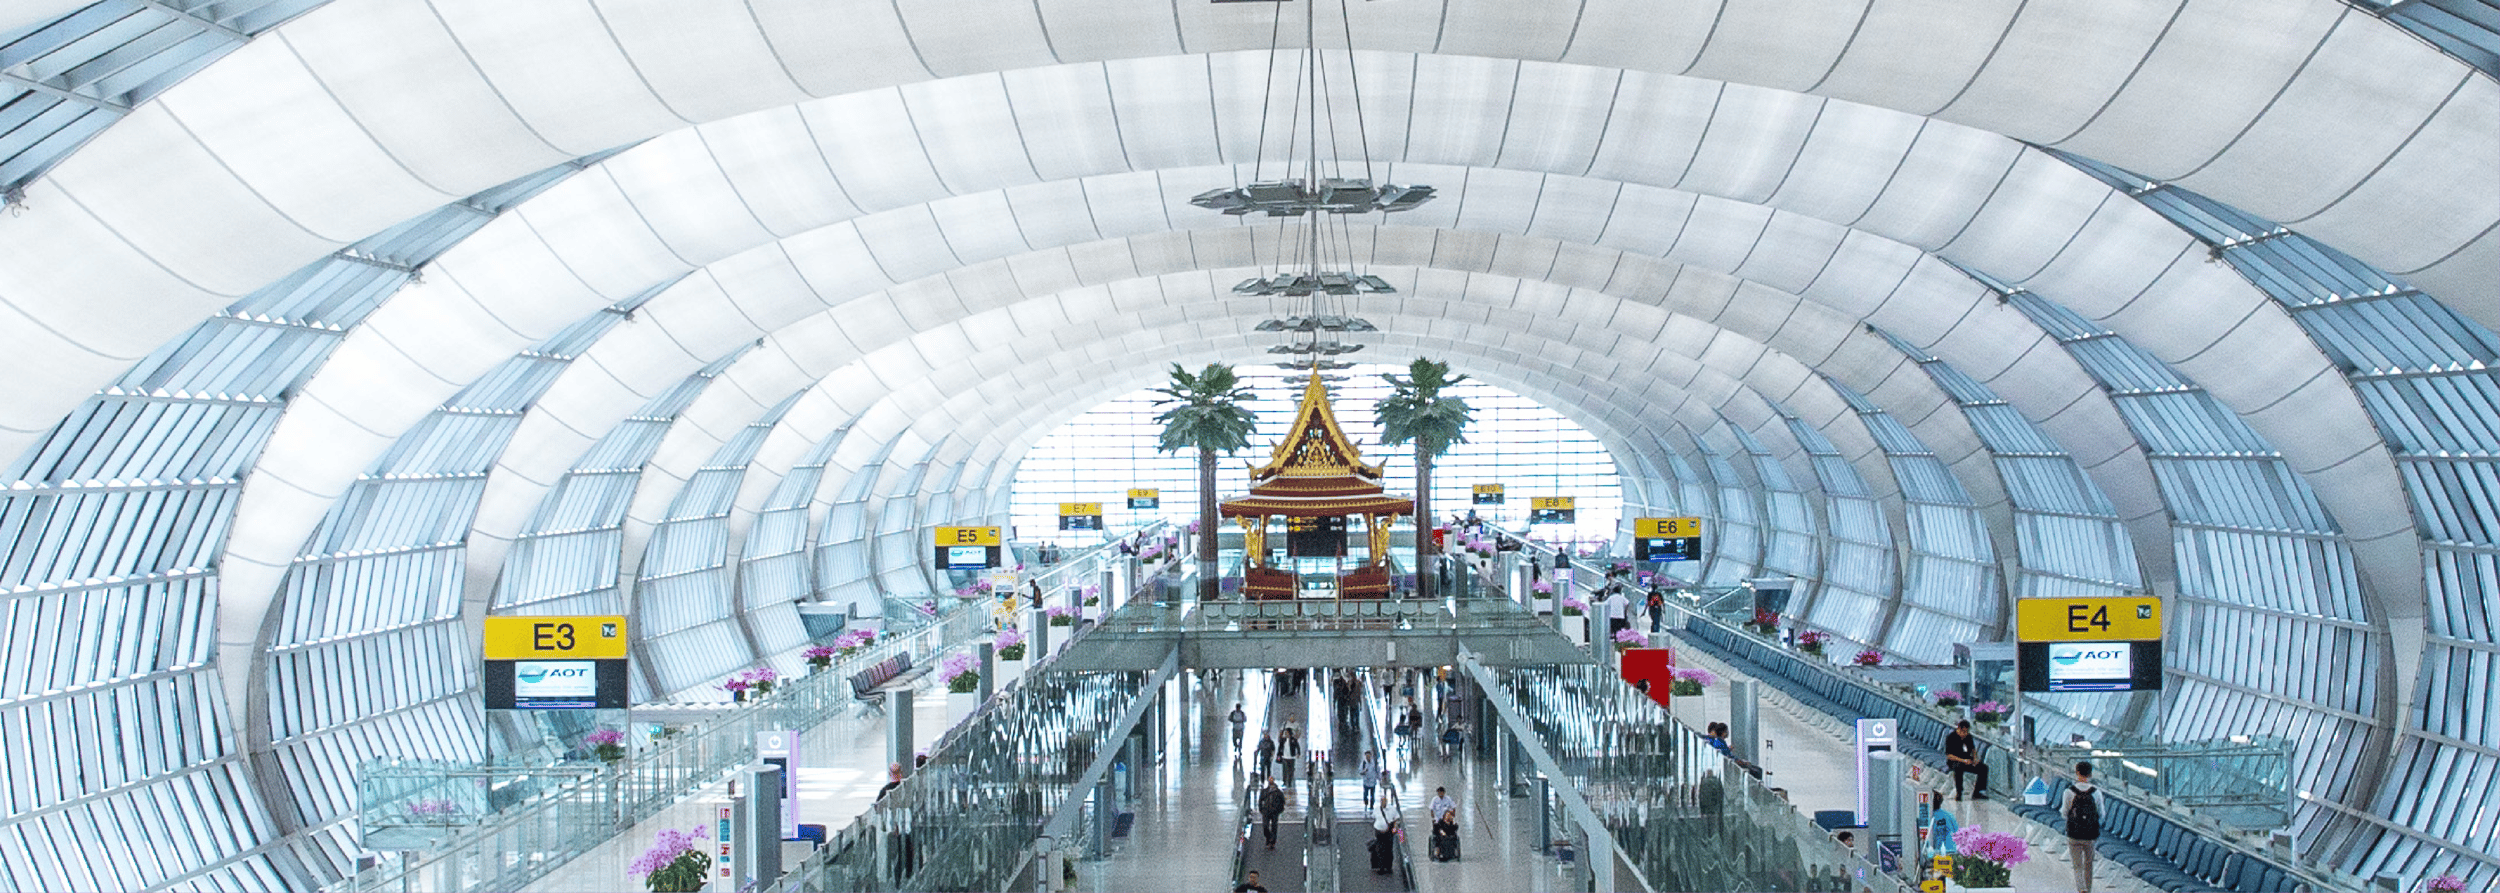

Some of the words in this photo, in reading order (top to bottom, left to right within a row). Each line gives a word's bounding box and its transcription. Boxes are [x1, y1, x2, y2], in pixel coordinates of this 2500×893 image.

[1073, 503, 1087, 513] E7
[1545, 498, 1559, 507] E8
[1657, 520, 1678, 534] E6
[957, 529, 978, 543] E5
[2068, 604, 2111, 632] E4
[533, 623, 576, 651] E3
[2084, 650, 2123, 659] AOT
[549, 668, 589, 677] AOT
